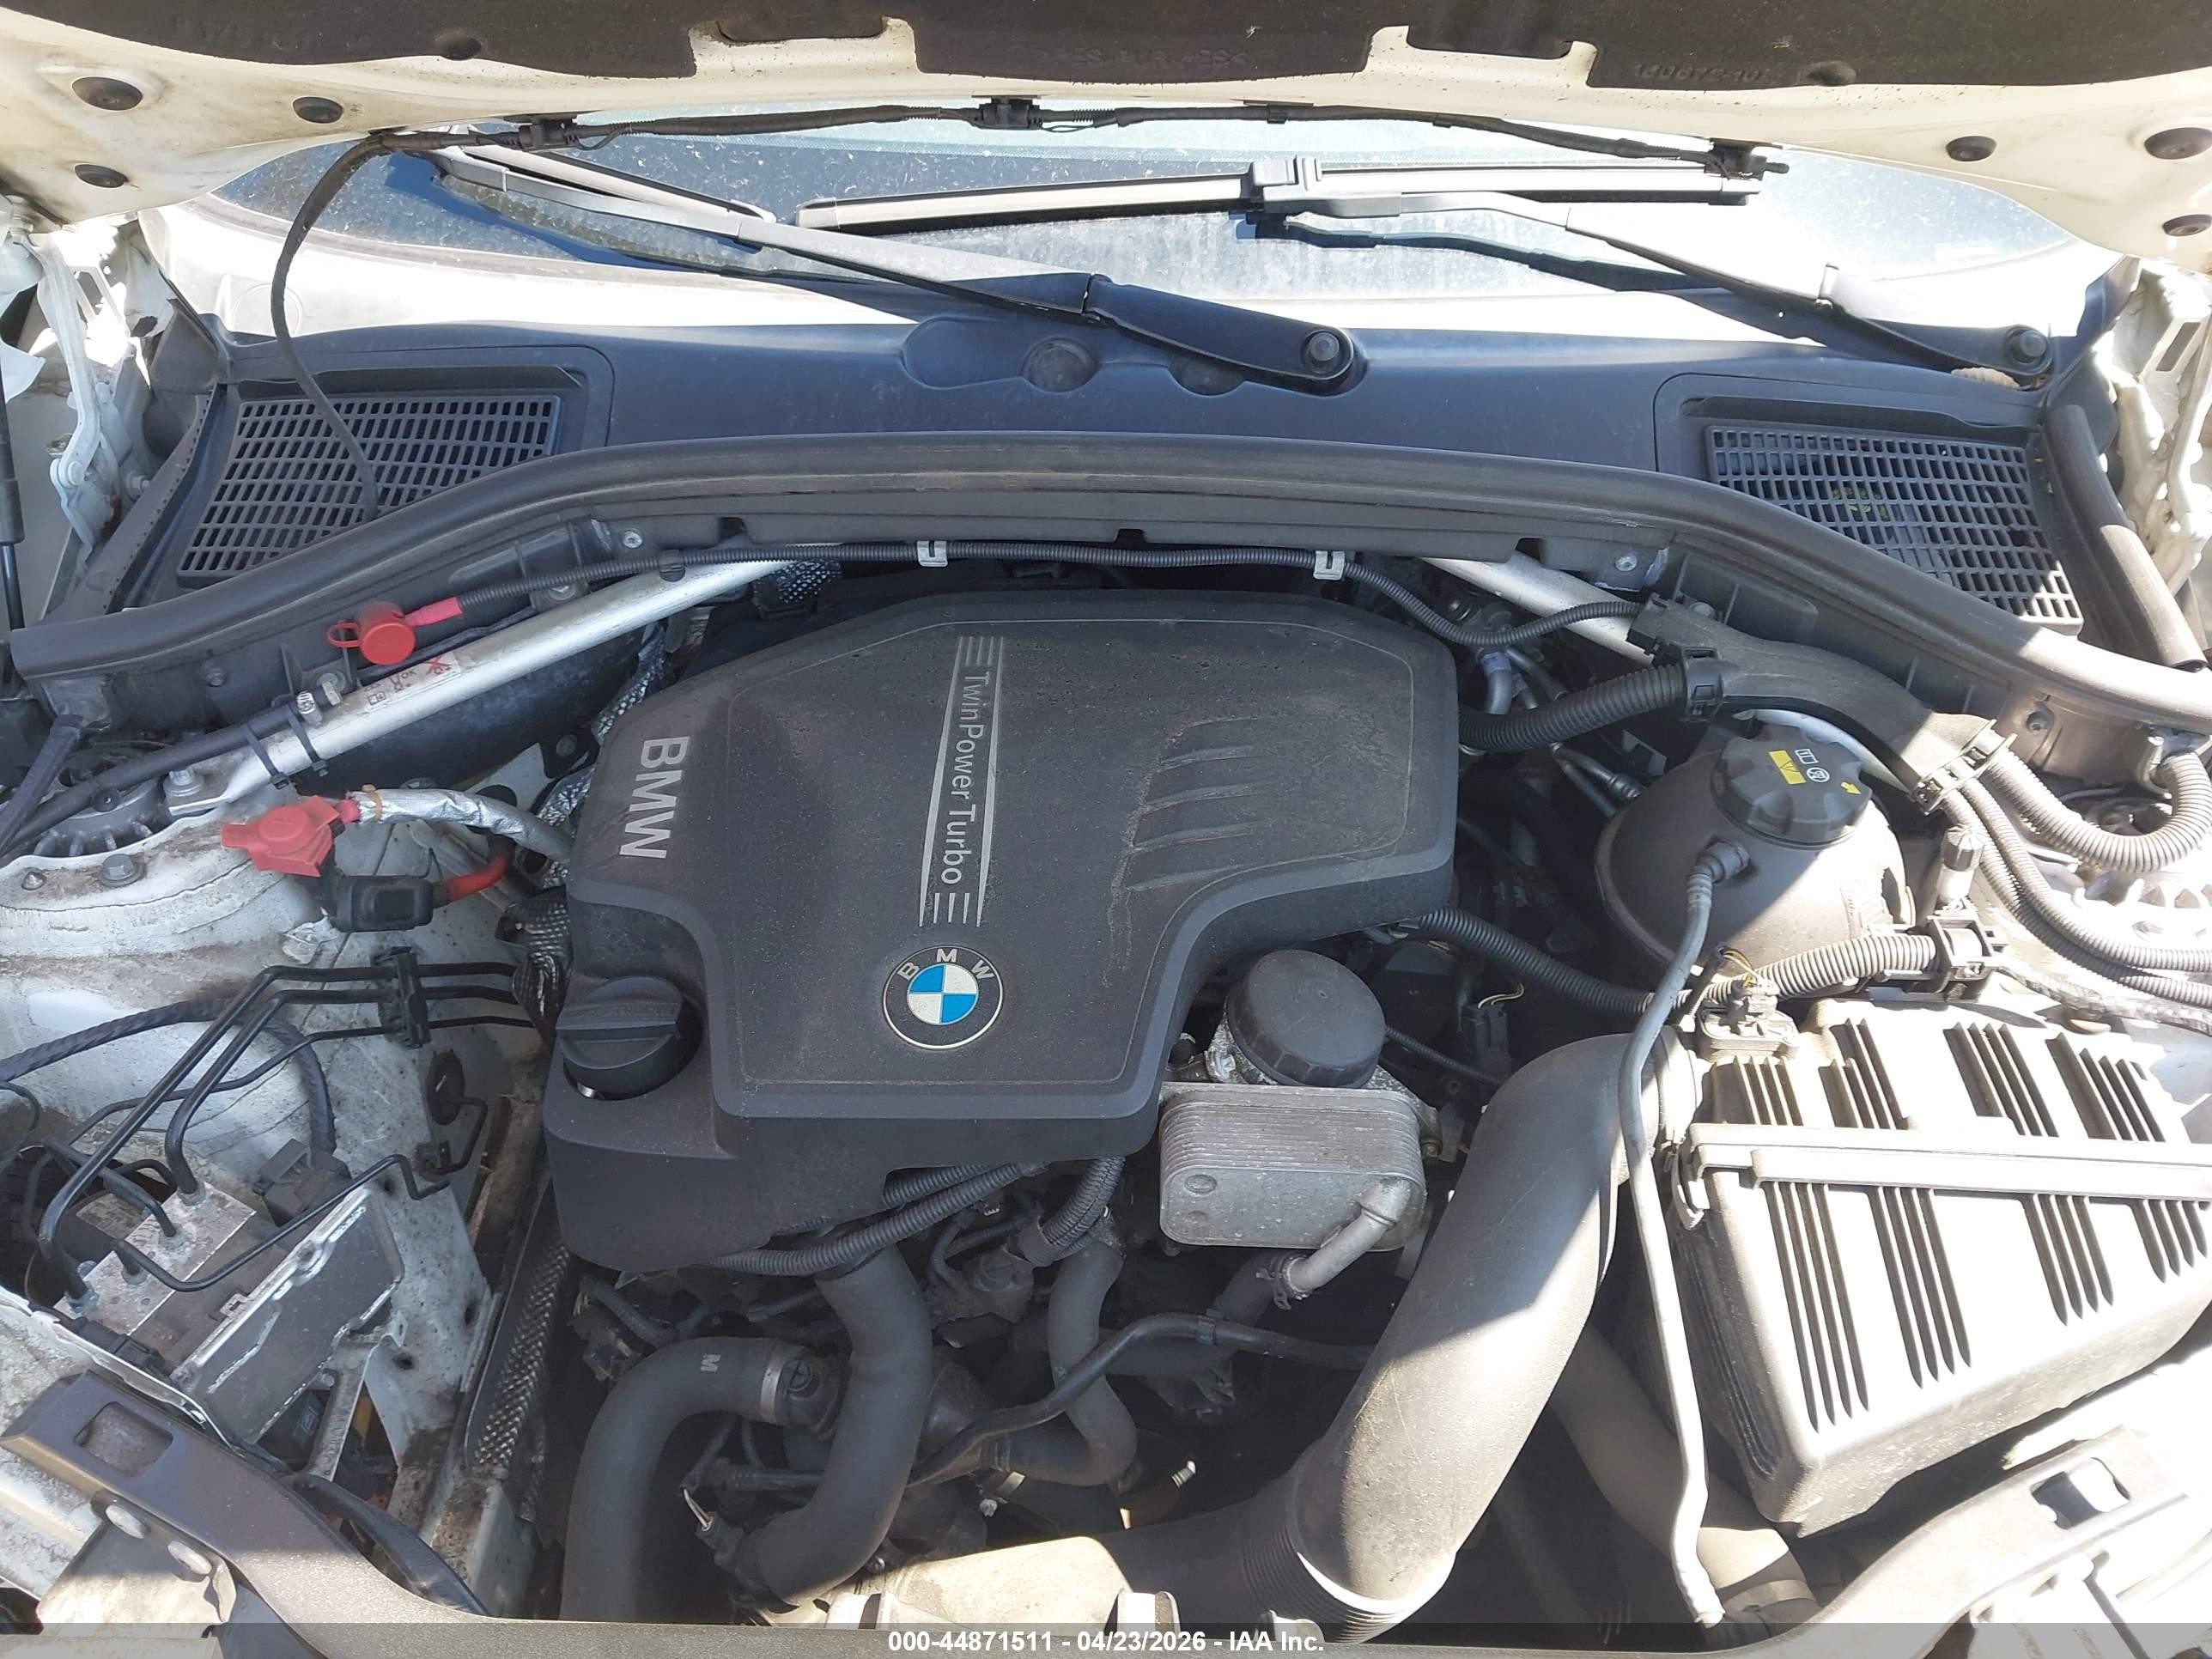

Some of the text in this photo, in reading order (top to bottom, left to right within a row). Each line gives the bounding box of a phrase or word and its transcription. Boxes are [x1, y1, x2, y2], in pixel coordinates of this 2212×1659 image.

[618, 736, 690, 860] BMW
[940, 671, 990, 884] TwinPower Turbo
[896, 948, 996, 981] BMW
